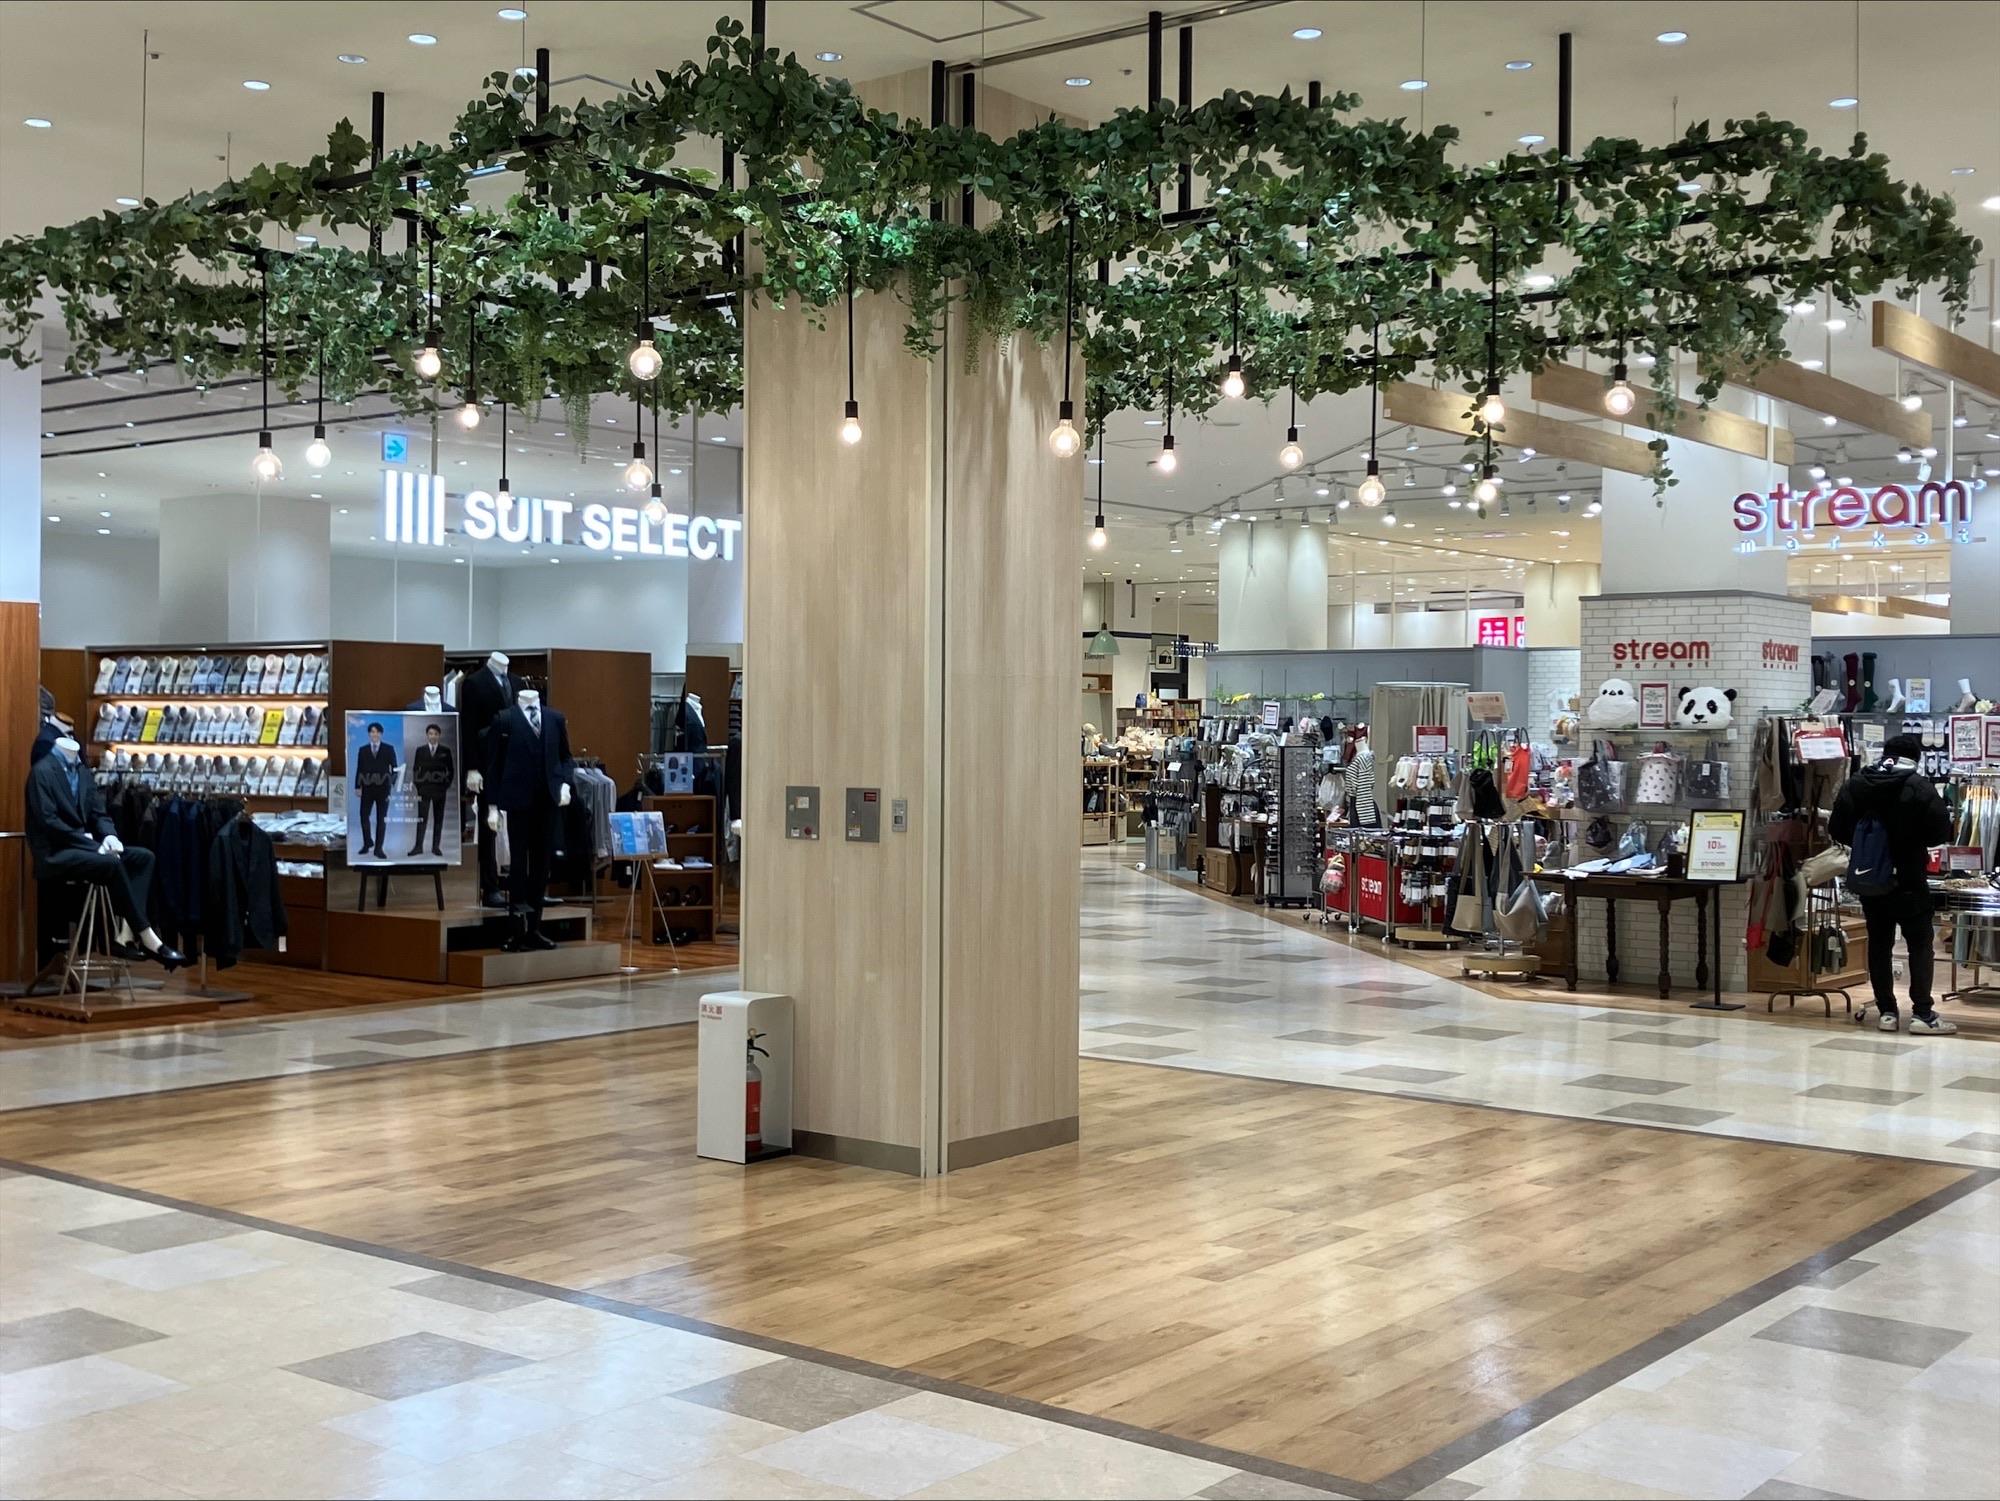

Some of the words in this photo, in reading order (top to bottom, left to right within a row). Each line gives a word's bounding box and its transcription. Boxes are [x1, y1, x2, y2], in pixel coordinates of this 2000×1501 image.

[1733, 480, 1972, 532] stream
[463, 491, 573, 546] SUIT
[581, 504, 741, 561] SELECT
[1740, 528, 1969, 554] market
[1613, 639, 1710, 660] stream
[1762, 638, 1799, 662] stream
[358, 772, 398, 786] NAVY
[408, 770, 450, 783] LACK
